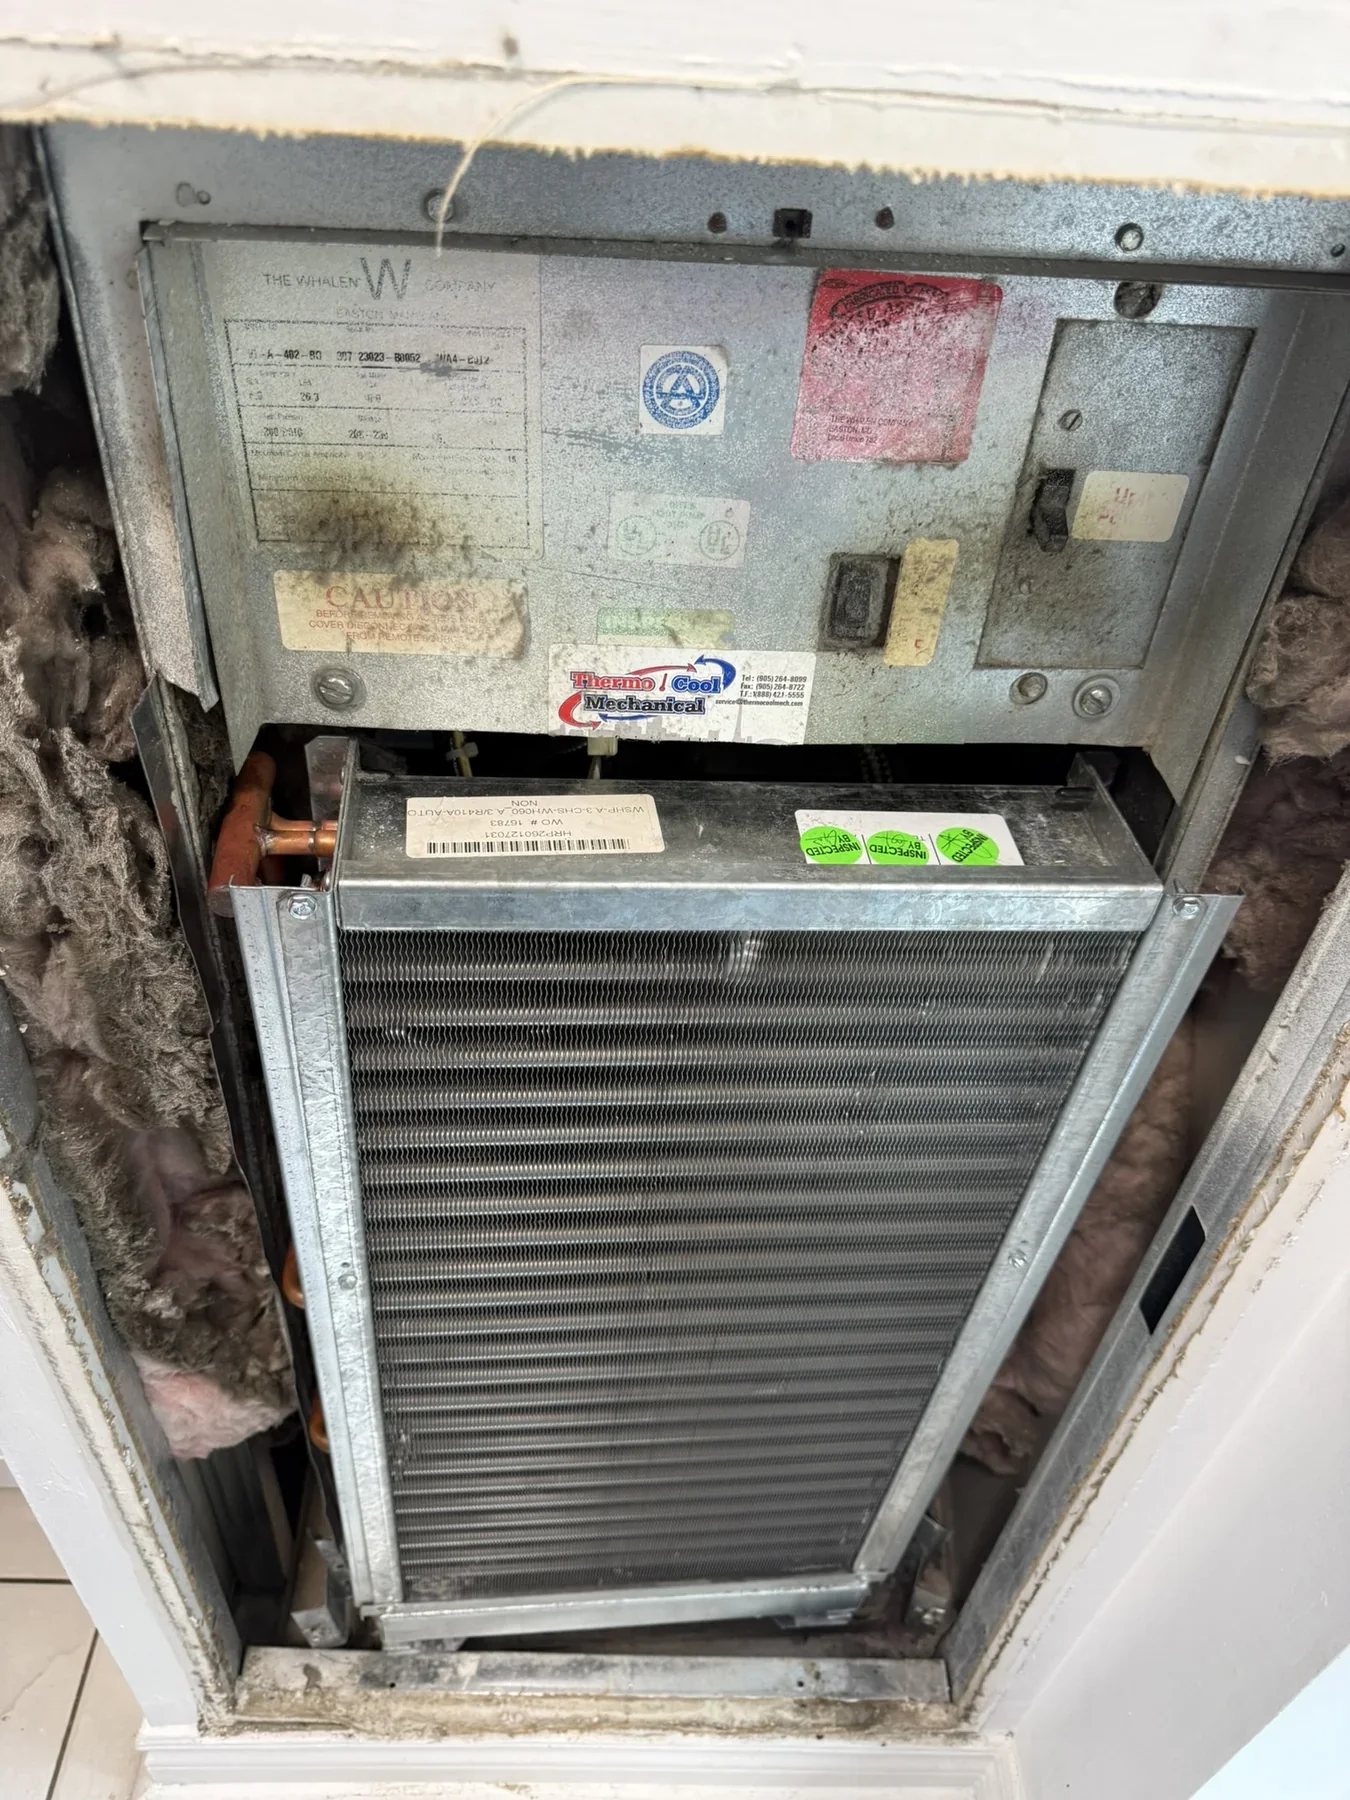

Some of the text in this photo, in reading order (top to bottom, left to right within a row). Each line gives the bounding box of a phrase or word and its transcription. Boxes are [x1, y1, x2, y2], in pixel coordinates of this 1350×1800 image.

[264, 273, 292, 287] THE
[296, 275, 361, 288] WHALEN
[325, 585, 478, 612] CAUTION
[309, 620, 345, 630] COVER
[346, 631, 376, 641] FROM
[379, 633, 421, 643] REMOTE
[570, 671, 721, 694] Thermo Cool
[756, 674, 774, 683] (905)
[775, 675, 808, 683] 264-8099
[755, 683, 773, 691] (905)
[773, 683, 806, 691] 264-8722
[583, 694, 706, 715] Mechanical
[714, 698, 804, 707] service@thermocoolmech.com
[510, 799, 538, 807] NON
[490, 818, 523, 827] 16783
[540, 818, 563, 827] WO
[485, 829, 572, 838] HRP260127031
[837, 833, 851, 844] BY
[961, 829, 974, 841] BY
[805, 841, 861, 857] INSPECTED
[908, 840, 921, 851] BY
[951, 833, 988, 863] INSPECTED
[868, 843, 927, 860] INSPECTED
